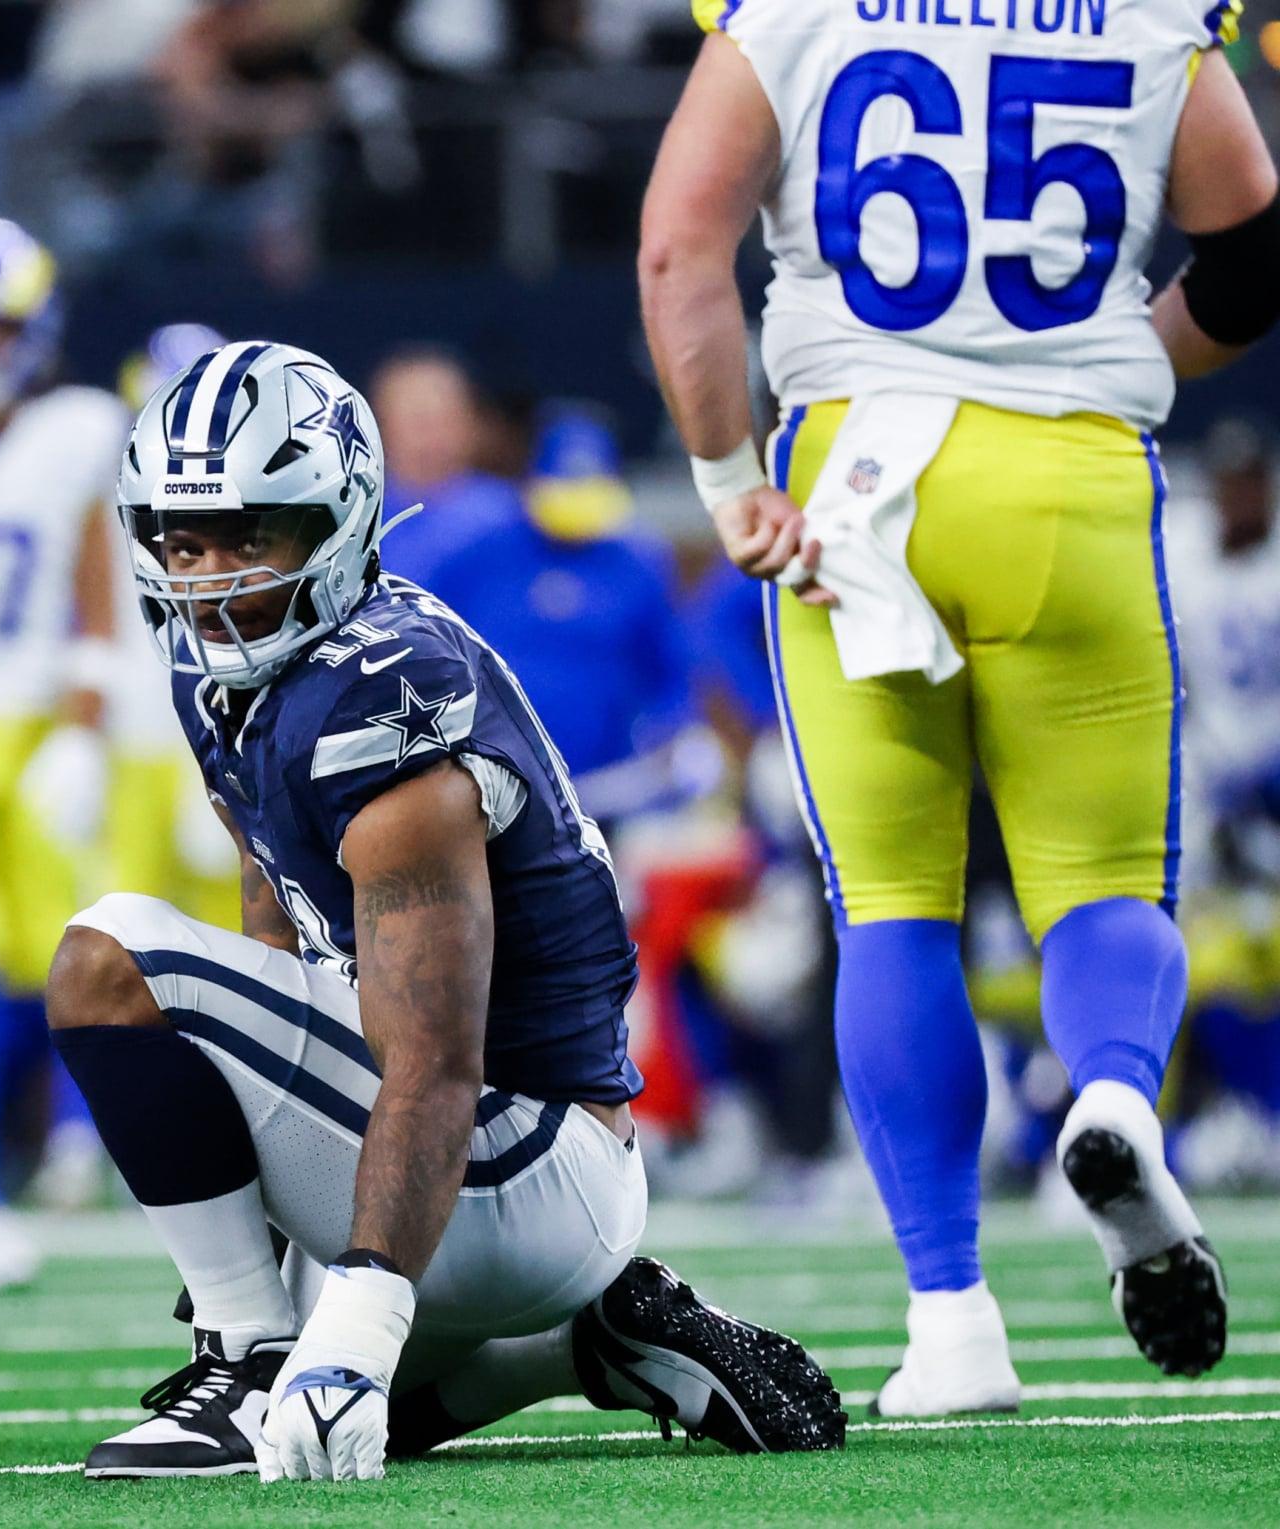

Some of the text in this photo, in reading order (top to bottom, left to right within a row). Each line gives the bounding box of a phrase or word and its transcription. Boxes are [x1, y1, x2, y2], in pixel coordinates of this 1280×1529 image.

[815, 50, 1135, 331] 65
[164, 483, 223, 494] COWBOYS
[308, 619, 400, 668] 11
